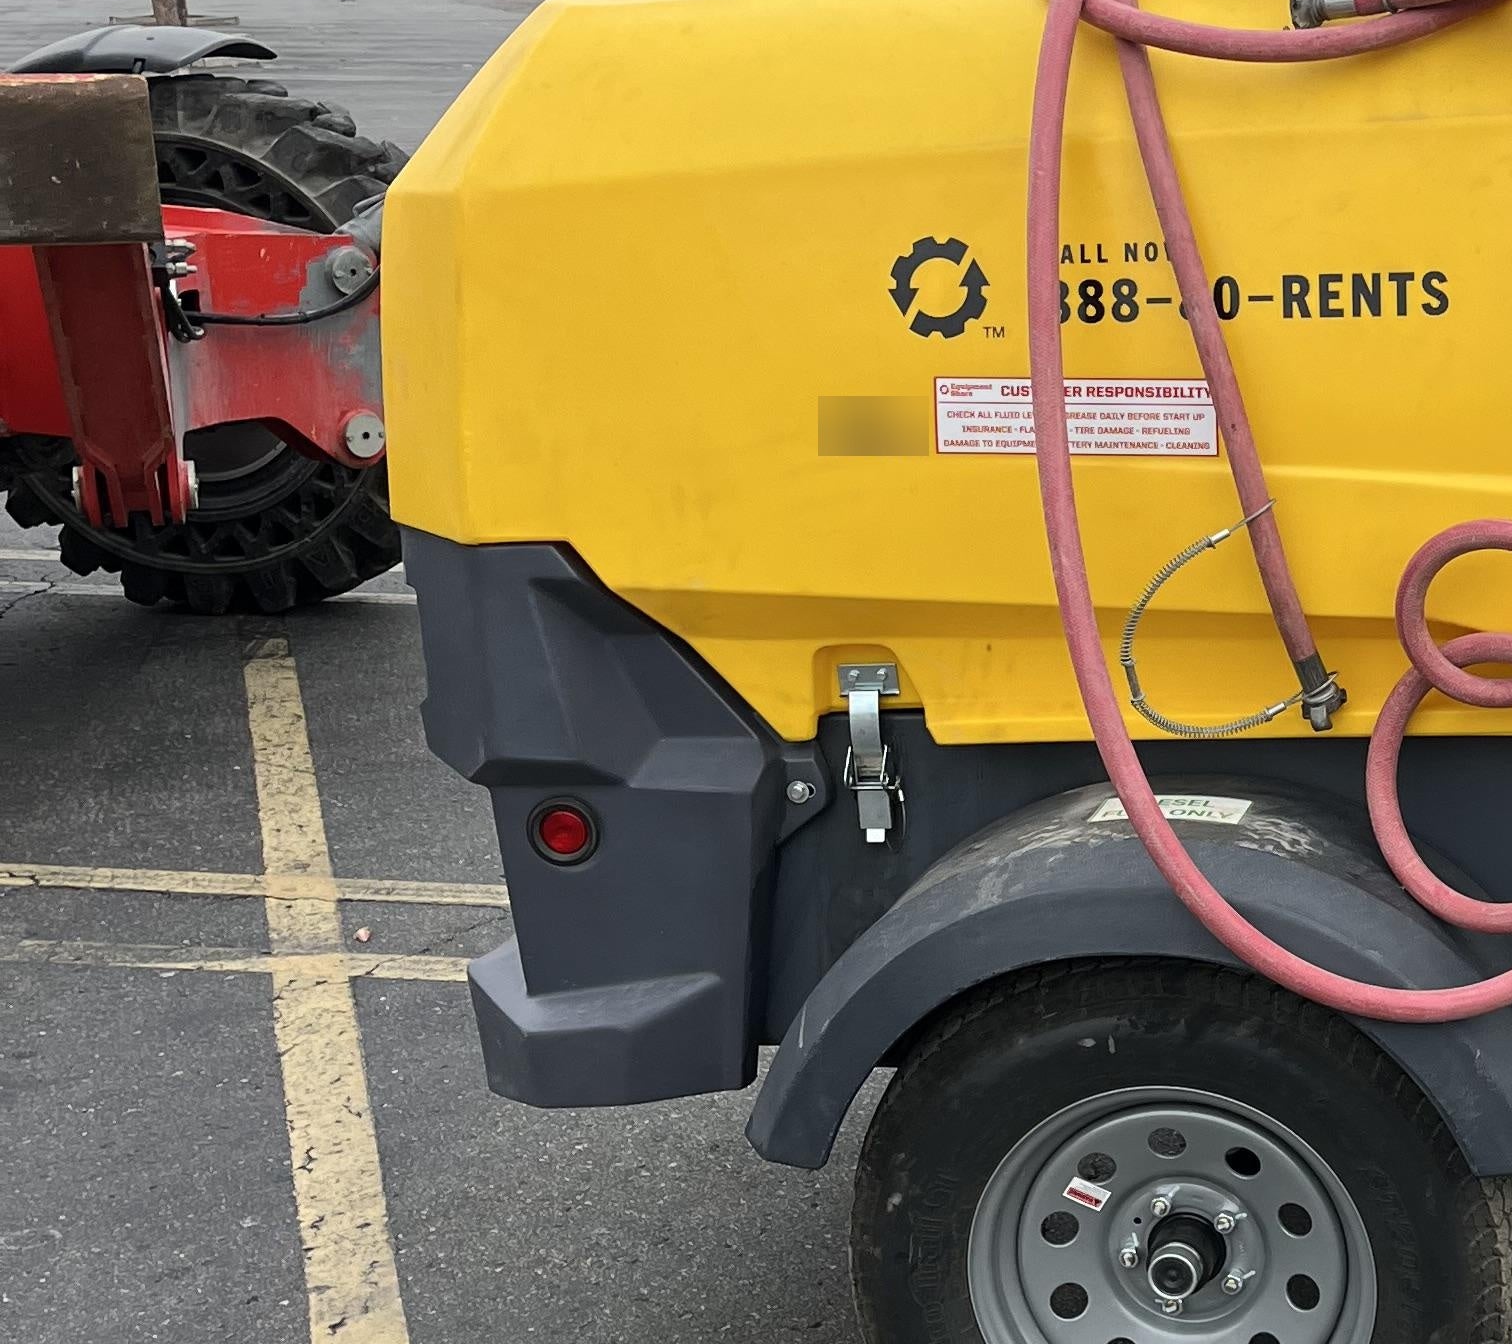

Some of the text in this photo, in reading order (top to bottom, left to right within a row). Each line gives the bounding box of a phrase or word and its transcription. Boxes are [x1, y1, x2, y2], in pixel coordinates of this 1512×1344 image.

[1060, 241, 1172, 264] ALL NO
[946, 410, 976, 419] CHECK
[977, 411, 993, 419] ALL
[994, 411, 1021, 419] FLUID
[1099, 413, 1126, 421] DAILY
[1127, 413, 1161, 421] BEFORE
[1163, 413, 1191, 421] START
[1192, 413, 1206, 421] UP
[961, 425, 1013, 434] INSURANCE
[1074, 426, 1098, 435] TIRE
[1097, 427, 1135, 435] DAMAGE
[1141, 427, 1191, 436] REFUELING
[943, 439, 980, 448] DAMAGE
[982, 439, 994, 447] TO
[1094, 441, 1159, 450] MAINTENANCE
[1165, 441, 1210, 450] CLEANING
[1158, 798, 1216, 808] ESEL
[1168, 808, 1235, 820] ONLY
